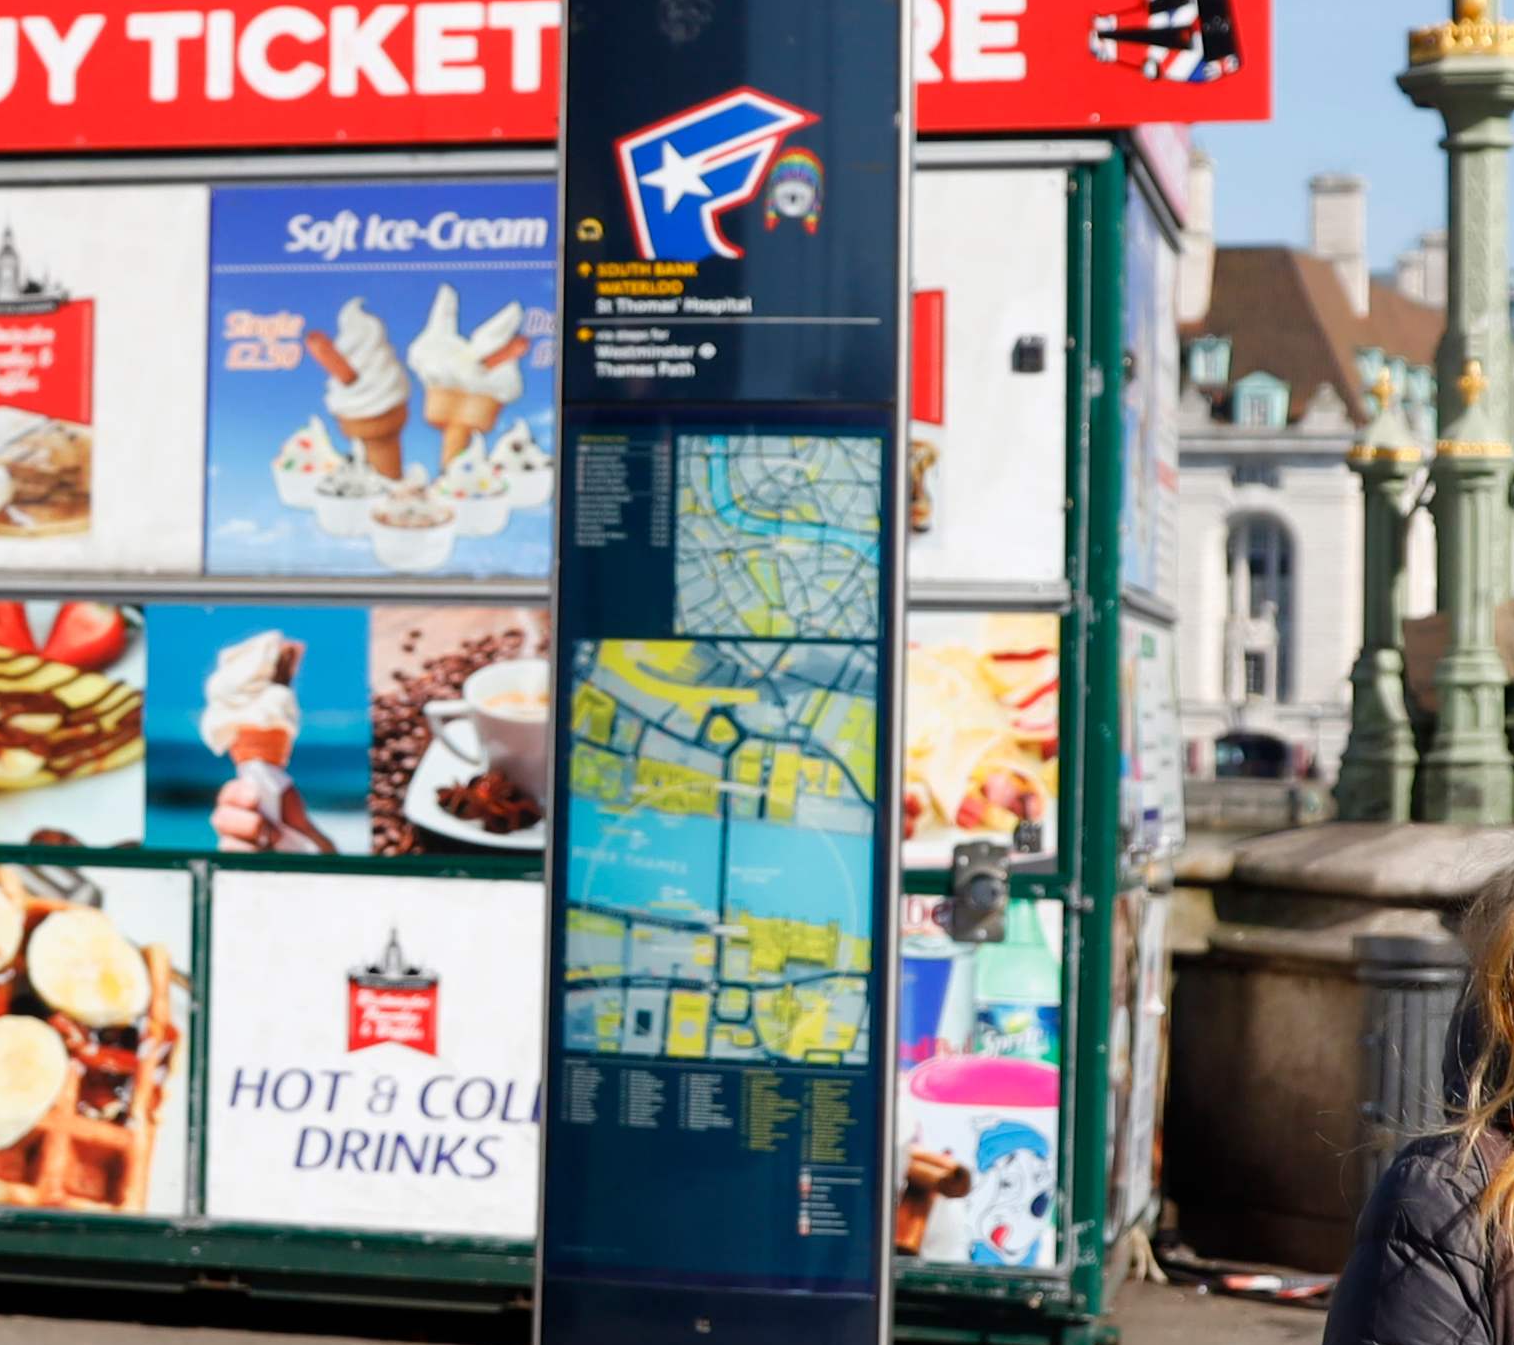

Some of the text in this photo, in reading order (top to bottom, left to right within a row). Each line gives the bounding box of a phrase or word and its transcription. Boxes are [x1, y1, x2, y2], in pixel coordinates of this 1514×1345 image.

[126, 0, 562, 103] TICKET
[284, 209, 549, 260] Soft Ice-Cream
[228, 1067, 353, 1114] HOT
[366, 1074, 398, 1116] &
[418, 1074, 541, 1124] COL
[293, 1125, 505, 1181] DRINKS
